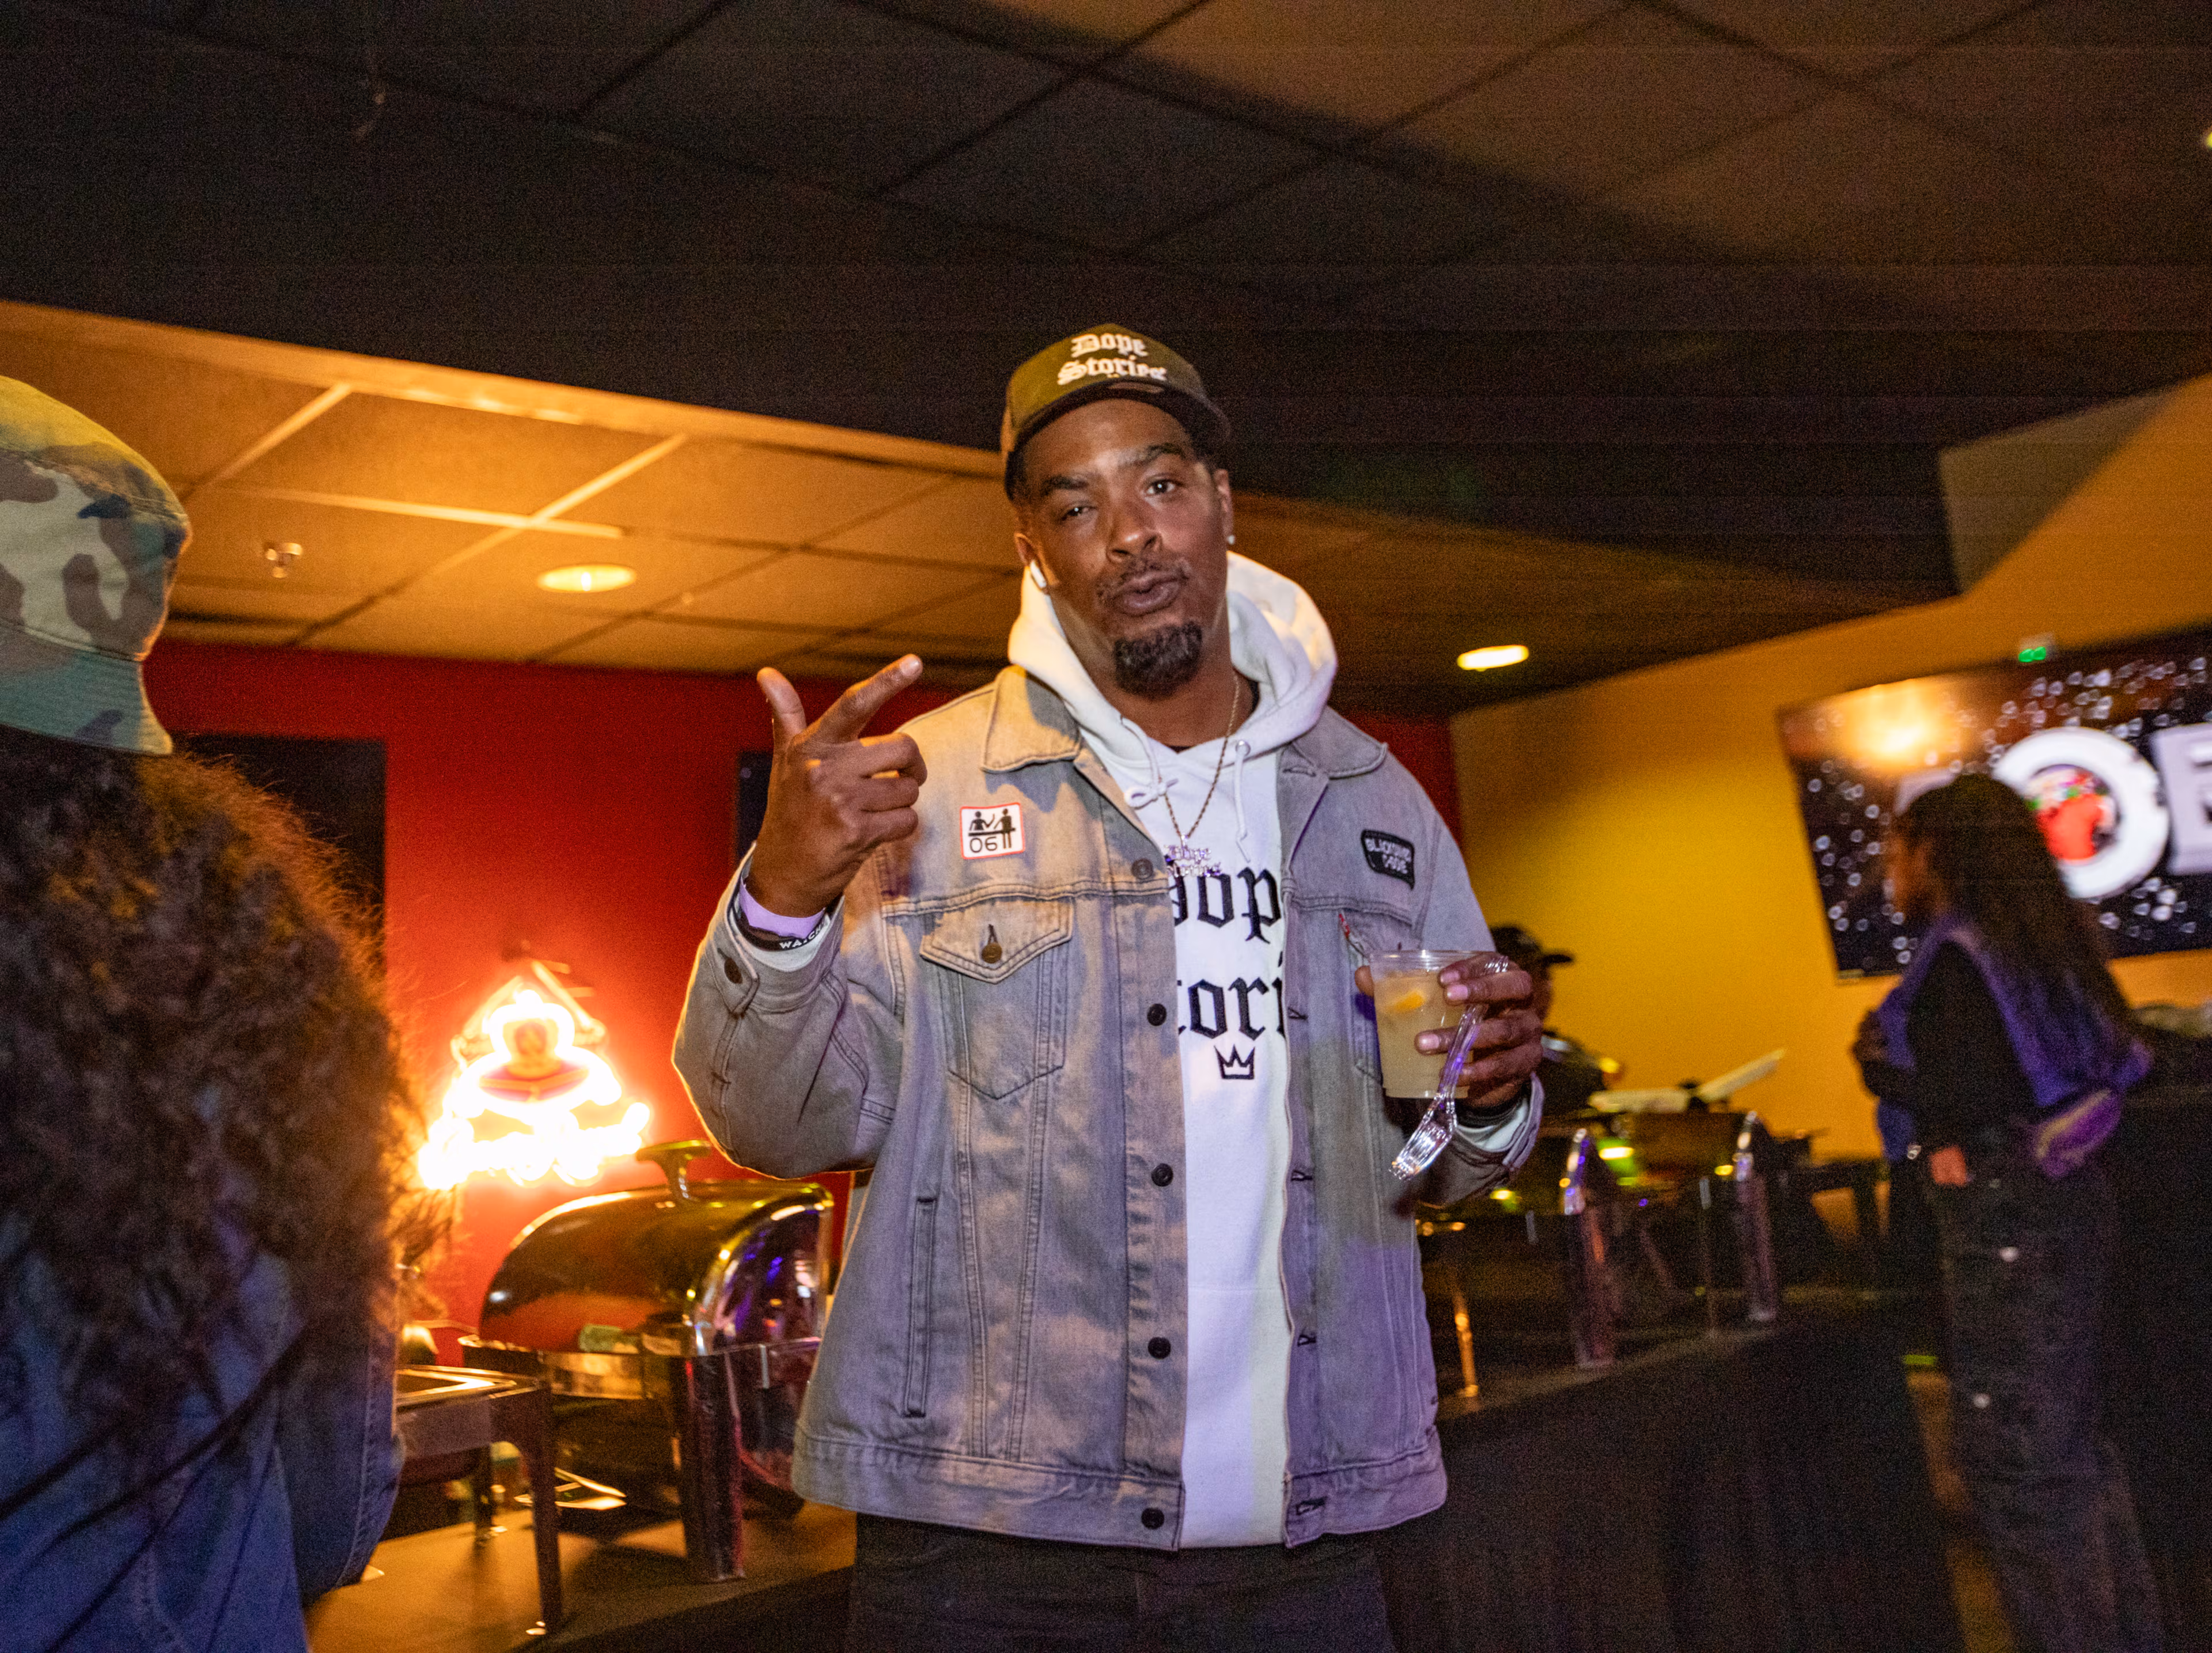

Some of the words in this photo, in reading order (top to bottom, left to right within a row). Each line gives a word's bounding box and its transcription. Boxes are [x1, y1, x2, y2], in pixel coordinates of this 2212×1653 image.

[1071, 333, 1149, 358] Dope
[1056, 355, 1168, 385] Stories
[969, 836, 998, 853] 06
